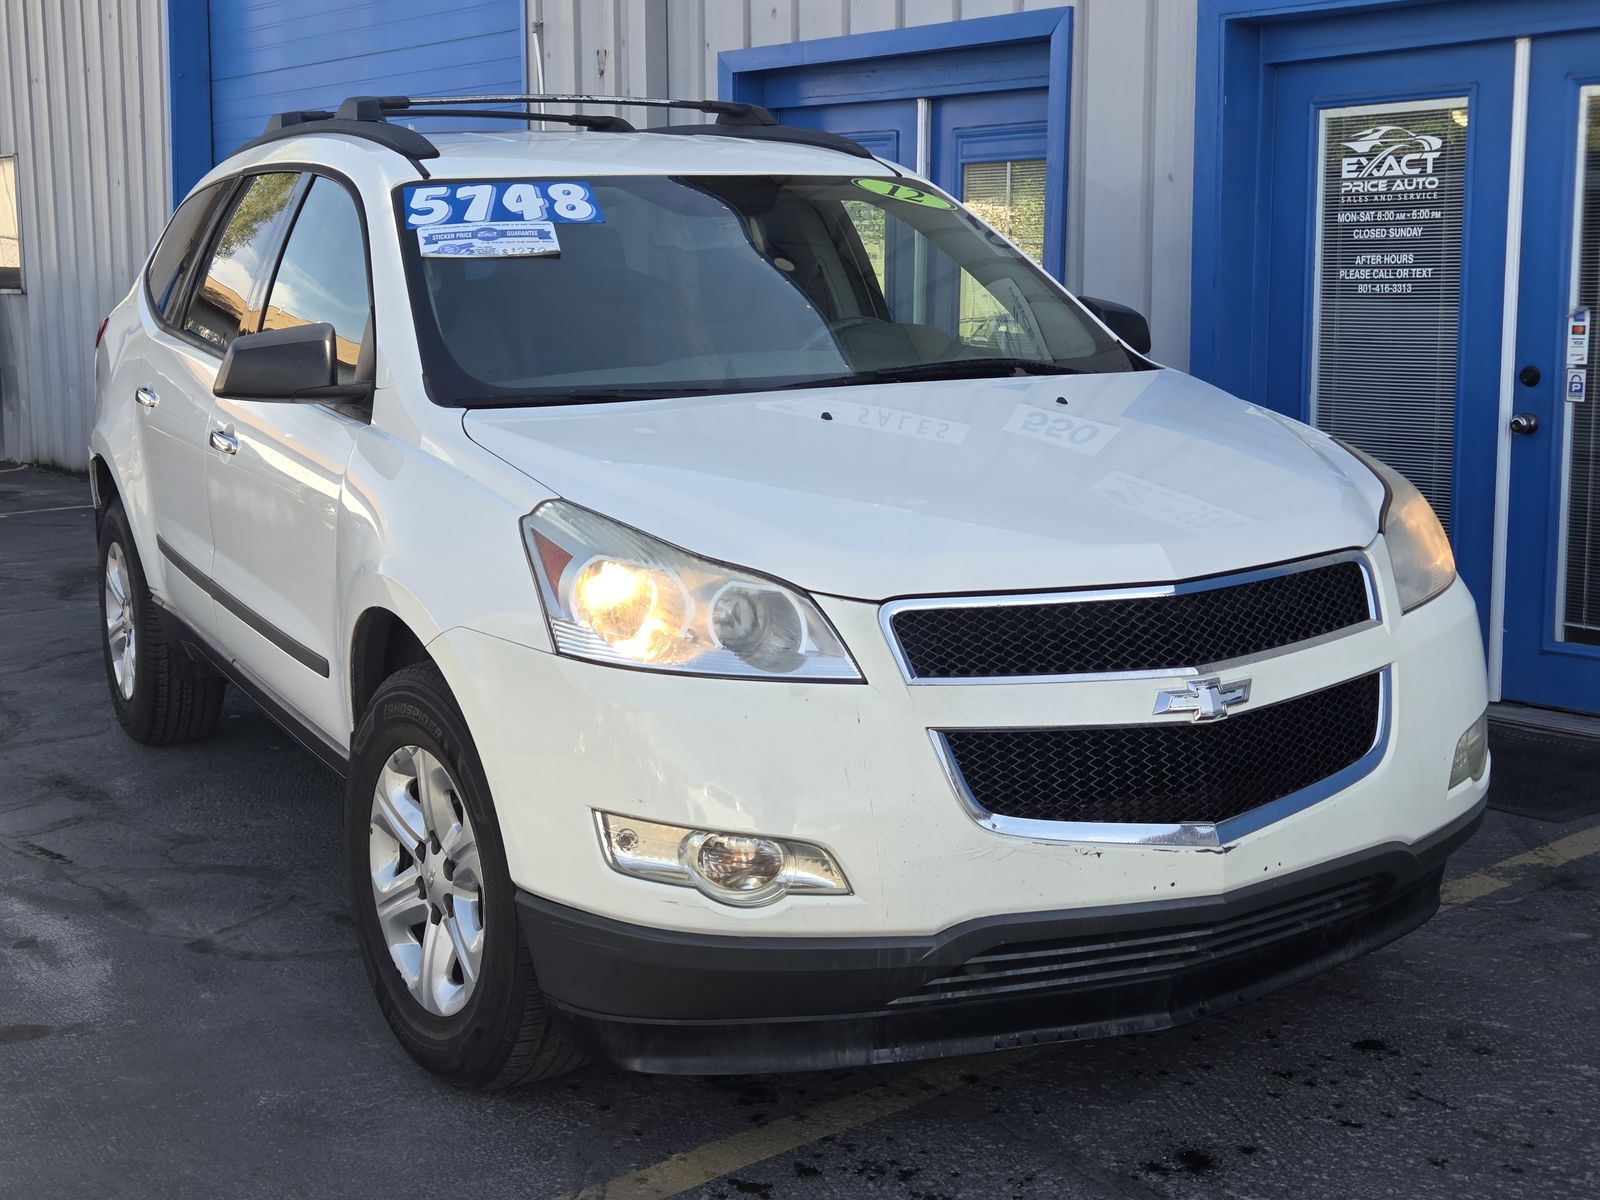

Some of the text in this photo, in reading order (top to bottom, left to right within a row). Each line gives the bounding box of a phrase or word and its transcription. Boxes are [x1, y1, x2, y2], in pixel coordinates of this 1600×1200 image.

[1341, 152, 1441, 178] EXACT
[1341, 177, 1439, 194] PRICE AUTO
[884, 183, 925, 203] 12
[1341, 191, 1439, 204] SALES AND SERVICE
[408, 183, 597, 225] 5748
[1337, 211, 1375, 223] MON-SAT
[1376, 210, 1395, 221] 8:00
[1395, 212, 1406, 220] AM
[1411, 209, 1430, 220] 6:00
[1431, 210, 1442, 219] PM
[431, 233, 455, 241] STICKER
[1353, 226, 1423, 239] CLOSED SUNDAY
[1355, 253, 1414, 265] AFTER HOURS
[1339, 267, 1434, 279] PLEASE CALL OR TEXT
[1358, 283, 1412, 294] 801-416-3313
